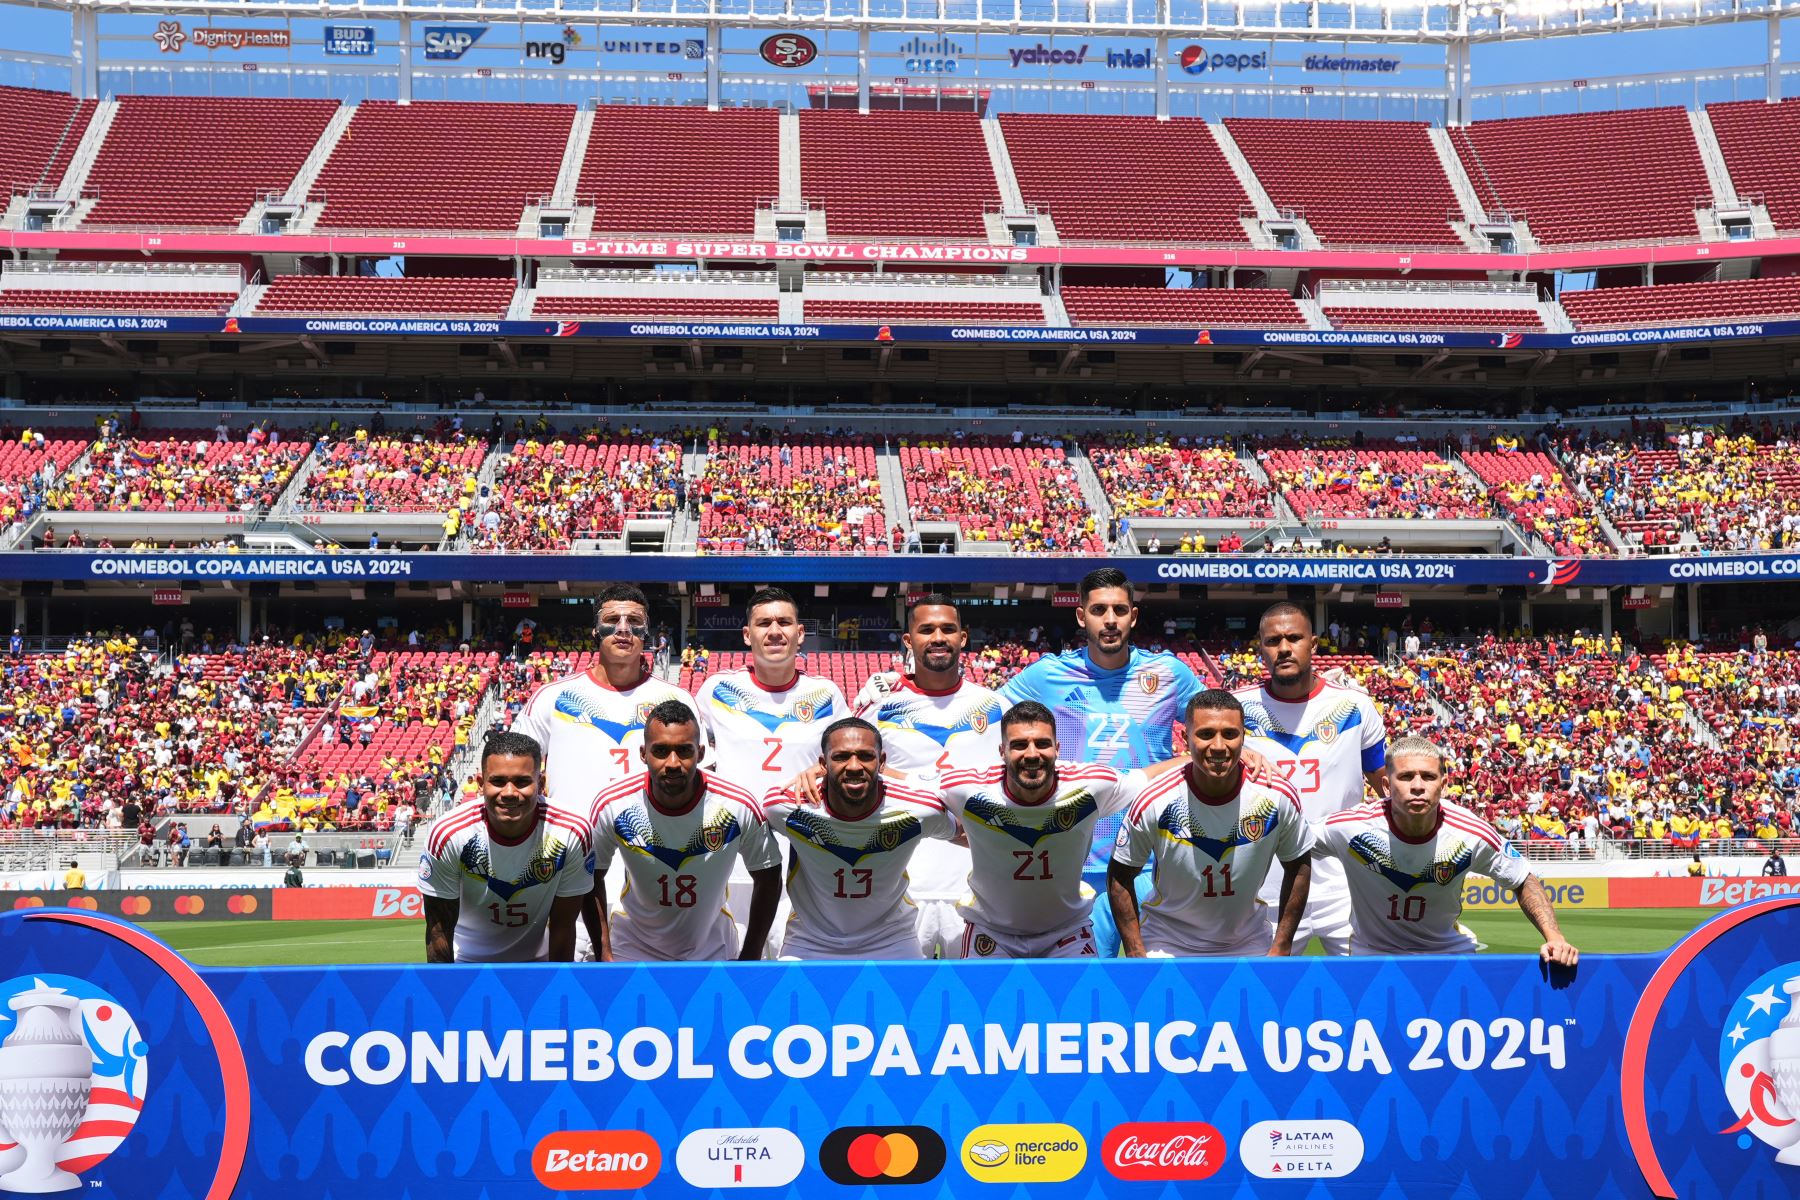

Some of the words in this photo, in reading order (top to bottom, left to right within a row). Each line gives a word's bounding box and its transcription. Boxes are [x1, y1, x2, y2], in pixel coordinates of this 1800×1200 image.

[193, 30, 242, 47] Dignity
[244, 32, 288, 45] Health
[334, 28, 365, 40] BUD
[425, 31, 473, 52] SAP
[327, 41, 370, 53] LIGHT
[526, 40, 565, 64] nrg
[604, 40, 681, 54] UNITED
[1009, 44, 1089, 68] yahoo!
[1106, 48, 1151, 68] intel
[1211, 51, 1267, 72] pepsi
[1304, 55, 1400, 72] ticketmaster
[905, 58, 957, 72] cisco
[572, 242, 668, 255] 5-TIME
[676, 243, 767, 257] SUPER
[775, 244, 854, 258] BOWL
[862, 246, 1028, 260] CHAMPIONS
[34, 318, 65, 328] COPA
[65, 318, 116, 329] AMERICA
[118, 319, 140, 329] USA
[141, 319, 168, 329] 2024
[306, 320, 368, 331] CONMEBOL
[369, 321, 399, 332] COPA
[400, 322, 449, 332] AMERICA
[451, 322, 472, 332] USA
[474, 322, 500, 332] 2024
[631, 325, 691, 336] CONMEBOL
[692, 325, 722, 336] COPA
[722, 325, 769, 336] AMERICA
[772, 327, 792, 337] USA
[794, 326, 820, 337] 2024
[952, 329, 1011, 339] CONMEBOL
[1012, 329, 1041, 340] COPA
[1041, 330, 1088, 340] AMERICA
[1090, 330, 1110, 341] USA
[1111, 331, 1136, 341] 2024
[1264, 333, 1322, 344] CONMEBOL
[1322, 333, 1351, 344] COPA
[1351, 334, 1397, 344] AMERICA
[1399, 334, 1419, 345] USA
[1420, 335, 1445, 345] 2024
[1571, 333, 1630, 345] CONMEBOL
[1632, 331, 1662, 342] COPA
[1662, 328, 1712, 341] AMERICA
[1714, 326, 1735, 337] USA
[1737, 324, 1763, 335] 2024
[91, 560, 194, 575] CONMEBOL
[196, 560, 245, 575] COPA
[247, 560, 327, 575] AMERICA
[332, 560, 366, 576] USA
[369, 560, 411, 575] 2024
[1158, 563, 1253, 578] CONMEBOL
[1255, 564, 1301, 578] COPA
[1301, 564, 1377, 578] AMERICA
[1381, 564, 1413, 579] USA
[1415, 564, 1454, 579] 2024
[1670, 560, 1769, 577] CONMEBOL
[1771, 559, 1800, 575] CO
[704, 614, 745, 628] xfinity
[857, 614, 890, 628] finity
[1088, 712, 1131, 748] 22
[762, 737, 783, 771] 2
[1276, 759, 1320, 793] 23
[1012, 850, 1054, 881] 21
[833, 868, 873, 899] 13
[1201, 864, 1236, 897] 11
[657, 874, 697, 908] 18
[372, 889, 426, 917] Be
[1387, 894, 1426, 922] 10
[488, 902, 529, 928] 15
[305, 1027, 714, 1085] CONMEBOL
[729, 1023, 922, 1079] COPA
[931, 1021, 1248, 1076] AMERICA
[1263, 1019, 1393, 1075] USA
[1407, 1018, 1567, 1071] 2024
[717, 1135, 760, 1146] Michelob
[1286, 1132, 1334, 1141] LATAM
[708, 1147, 771, 1161] ULTRA
[1015, 1140, 1079, 1152] mercado
[545, 1149, 648, 1172] Betano
[1015, 1153, 1046, 1165] libre
[1287, 1162, 1333, 1171] DELTA
